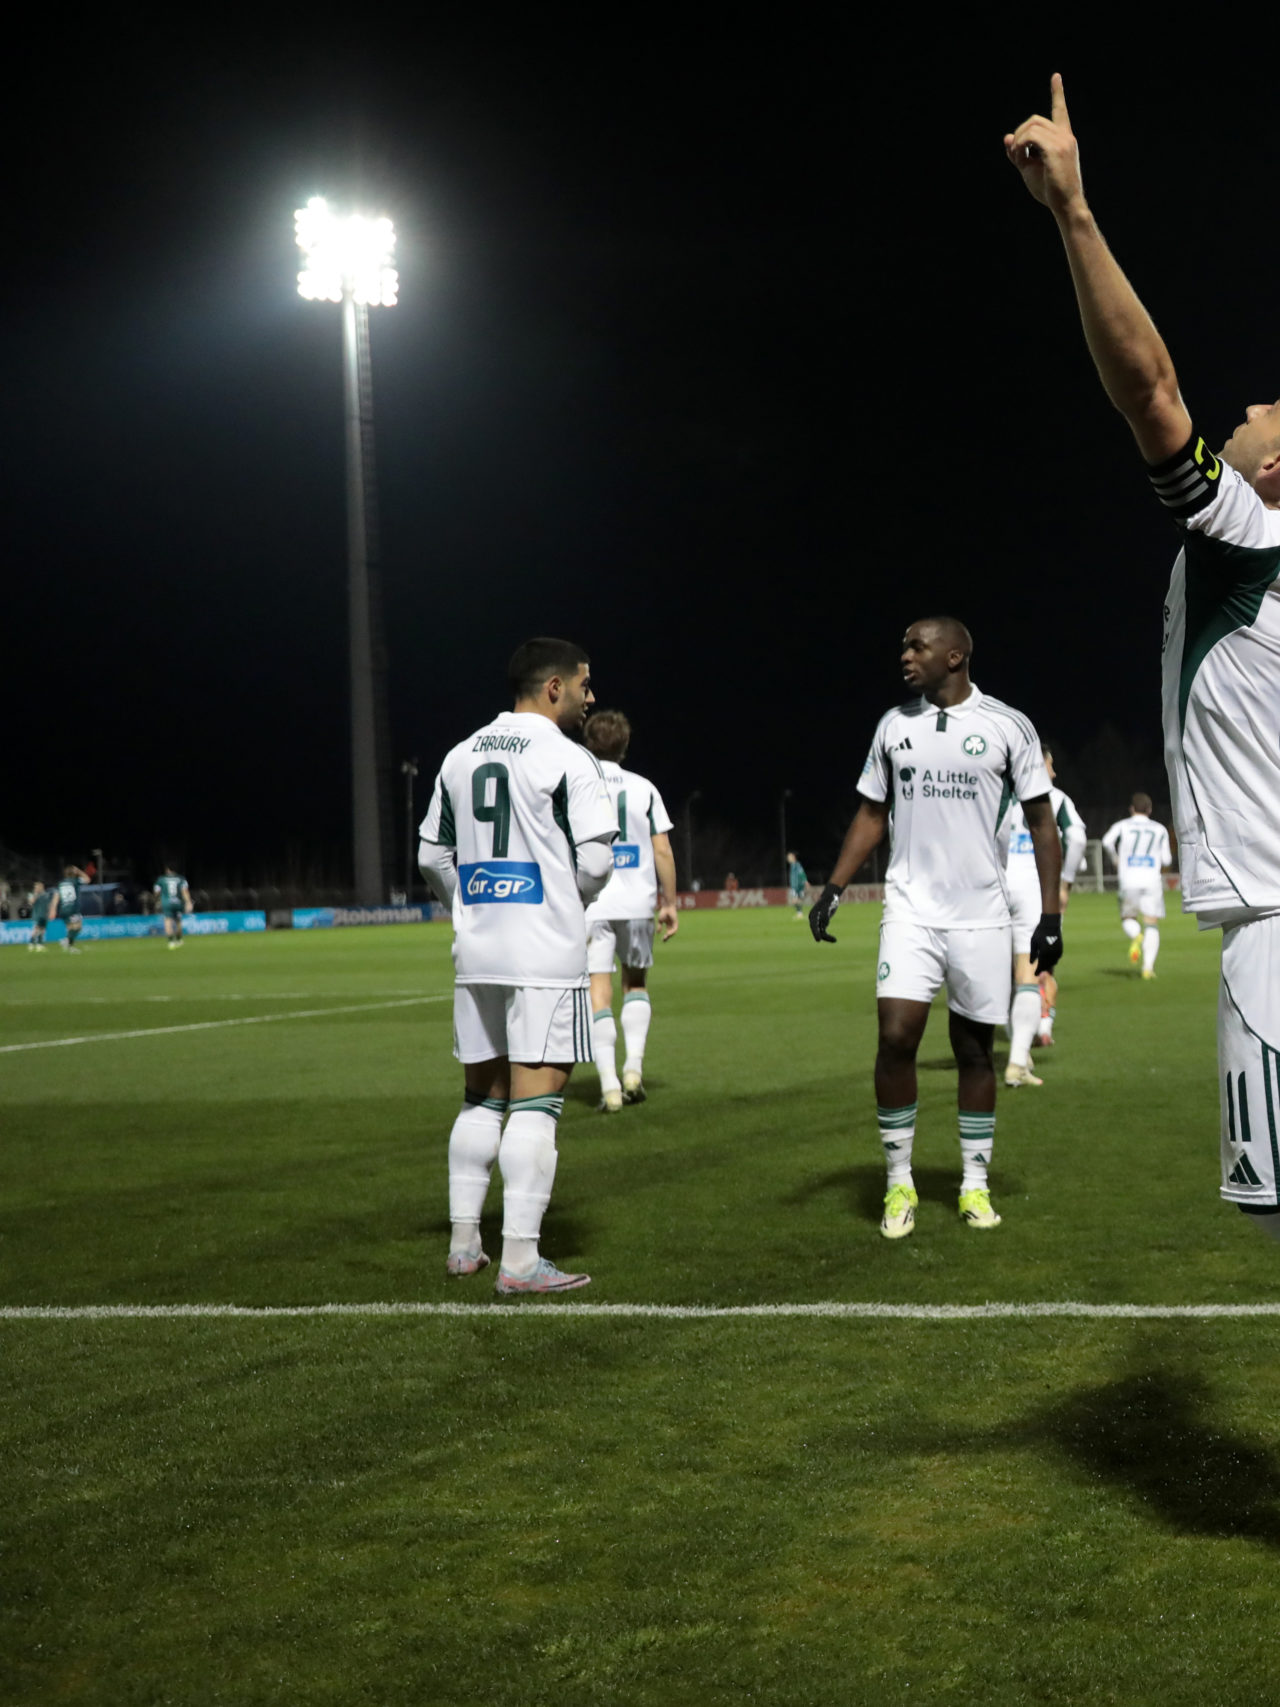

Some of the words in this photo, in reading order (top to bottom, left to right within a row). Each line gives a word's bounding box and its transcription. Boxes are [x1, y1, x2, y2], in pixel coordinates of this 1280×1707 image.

[472, 735, 531, 754] ZAROURY
[922, 769, 933, 782] A
[937, 769, 978, 785] Little
[922, 785, 979, 800] Shelter
[472, 762, 510, 858] 9
[1129, 829, 1156, 856] 77
[717, 888, 768, 909] SYM
[1226, 1070, 1252, 1143] 11
